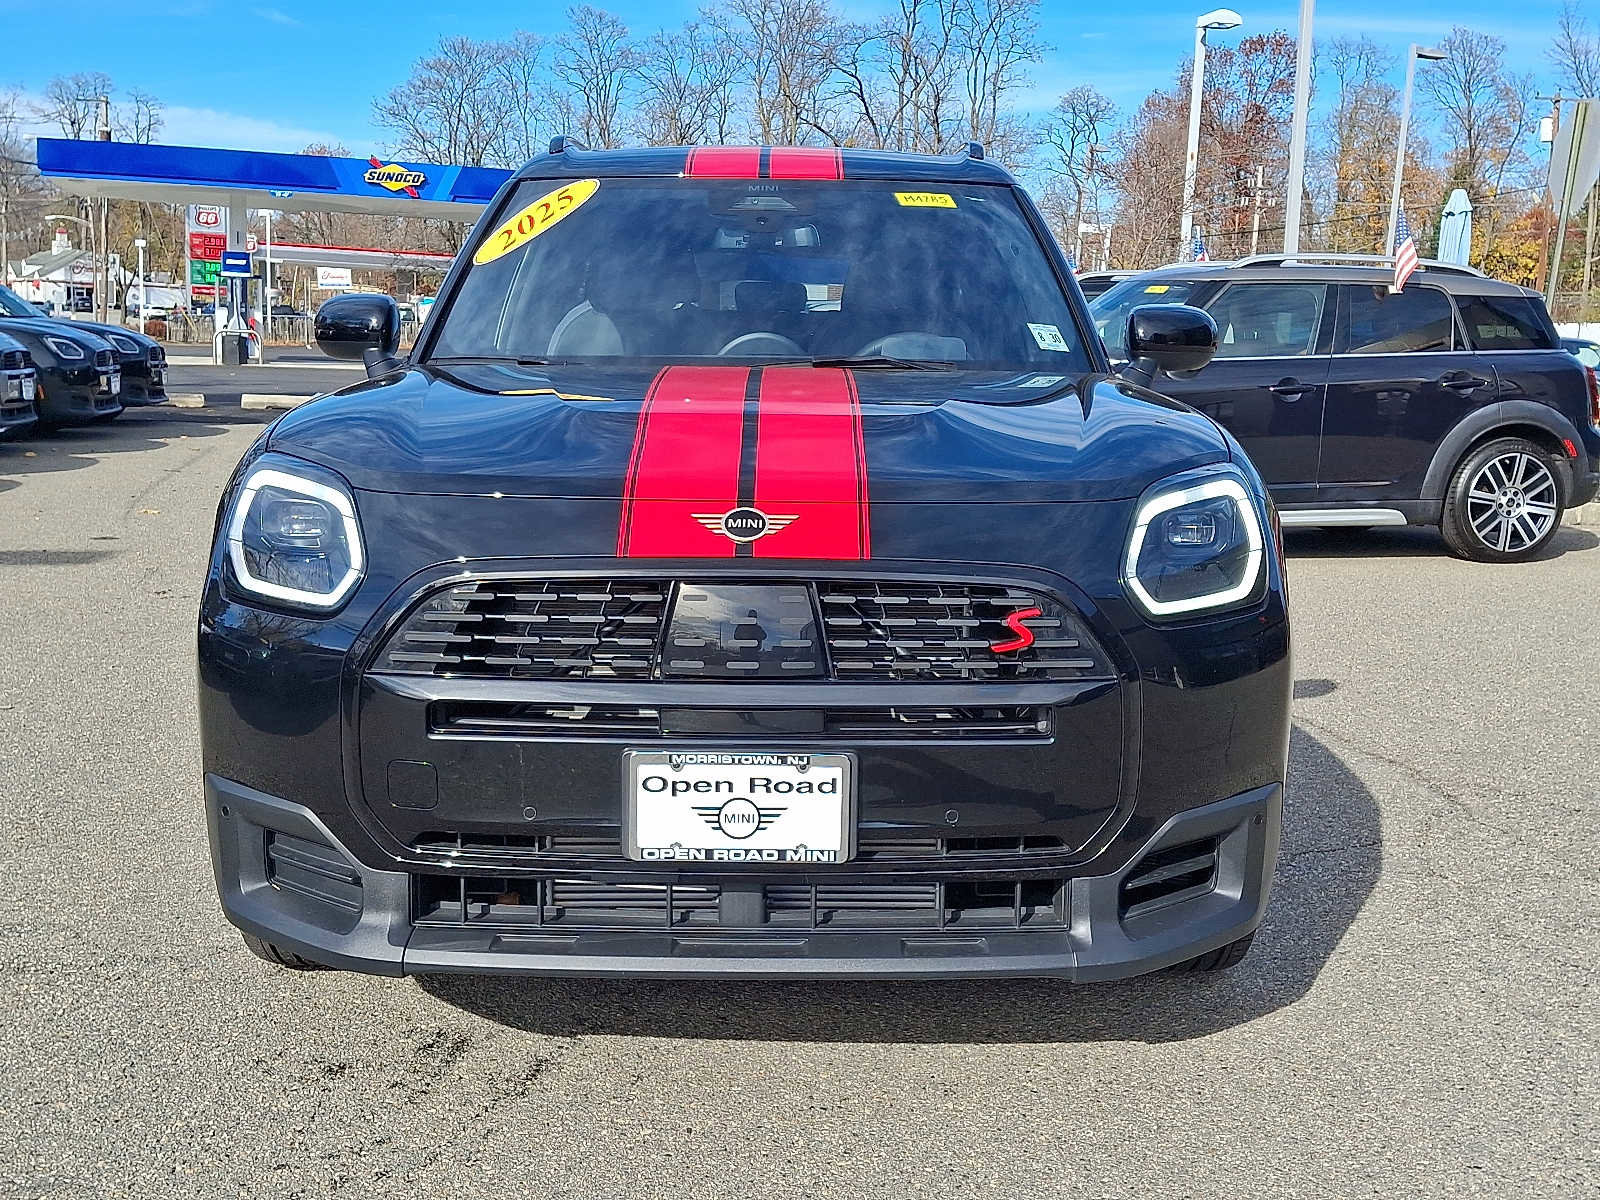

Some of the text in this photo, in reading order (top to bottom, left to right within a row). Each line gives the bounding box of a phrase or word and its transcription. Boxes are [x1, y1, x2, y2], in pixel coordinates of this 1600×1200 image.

[367, 170, 421, 184] SUNOCO
[748, 185, 780, 193] MINI
[198, 213, 217, 224] 66
[497, 188, 574, 252] 2025
[1037, 331, 1062, 344] 8 30
[727, 518, 763, 529] MINI
[990, 606, 1042, 653] S
[787, 755, 808, 765] NJ
[642, 775, 837, 797] Open Road
[724, 813, 755, 825] MINI
[642, 848, 836, 862] OPEN ROAD MINI
